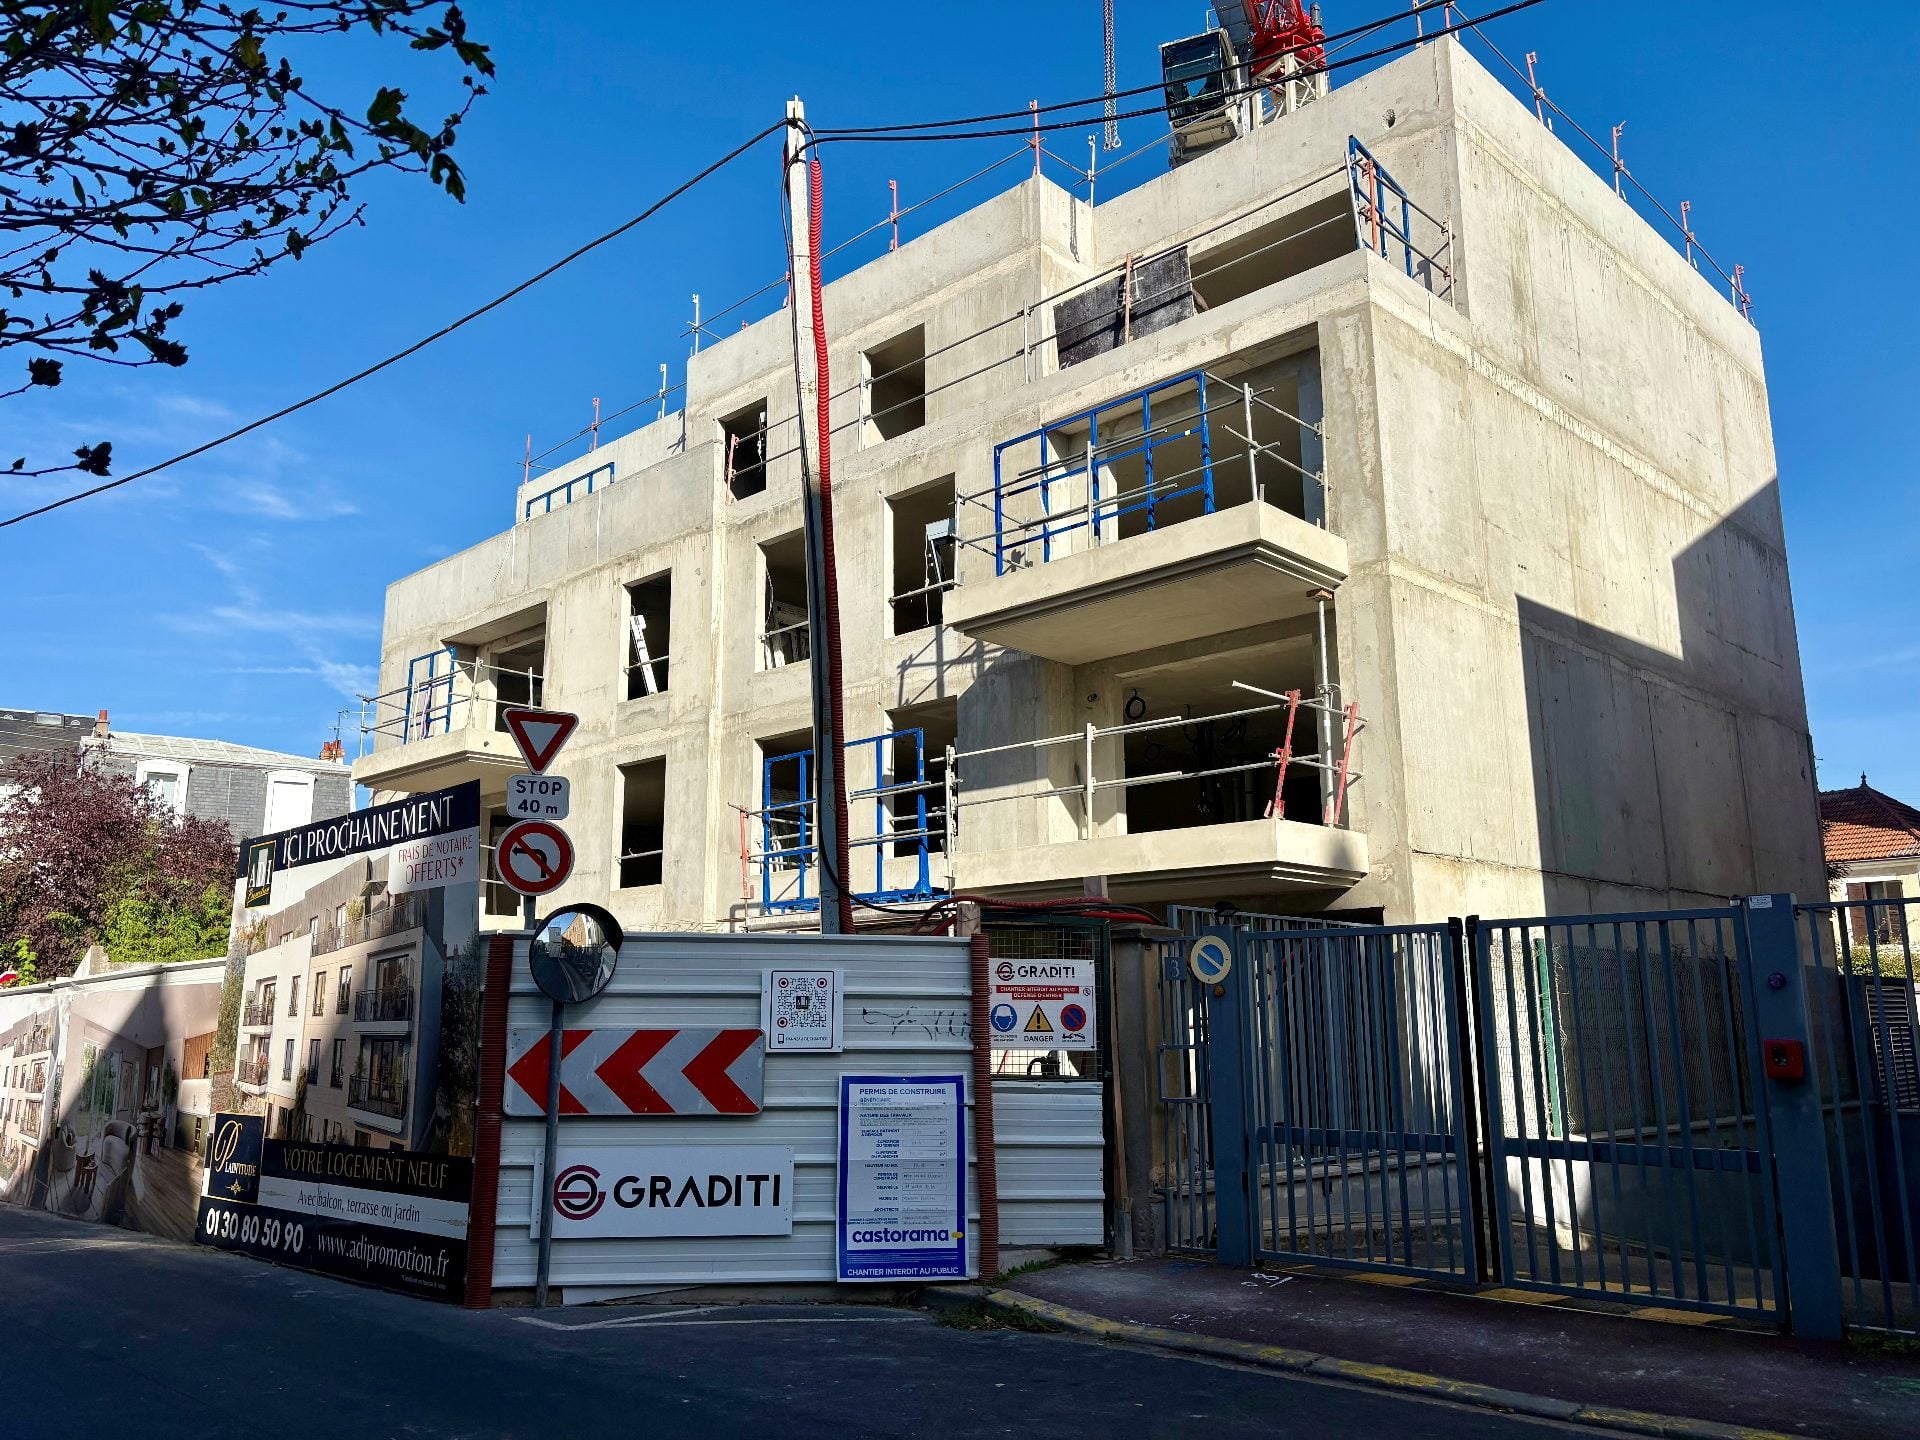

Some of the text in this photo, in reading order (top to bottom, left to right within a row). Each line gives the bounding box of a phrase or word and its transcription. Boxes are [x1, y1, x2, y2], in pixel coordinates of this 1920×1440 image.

[515, 780, 562, 796] STOP
[518, 799, 558, 814] 40 m
[282, 795, 454, 865] ICI PROCHAINEMENT
[398, 834, 473, 864] FRAIS DE NOTAIRE
[1017, 966, 1076, 979] GRADITI
[1170, 960, 1180, 978] 3
[1023, 1035, 1054, 1043] DANGER
[283, 1148, 449, 1189] VOTRE LOGEMENT NEUF
[613, 1174, 781, 1209] GRADITI
[297, 1190, 421, 1226] Avec balcon, terrasse ou jardin
[206, 1207, 304, 1254] 01 30 80 50 90
[852, 1228, 949, 1243] castorama
[317, 1233, 450, 1278] www.adipromotion.fr
[847, 1268, 884, 1276] CHANTIER
[932, 1266, 959, 1274] PUBLIC
